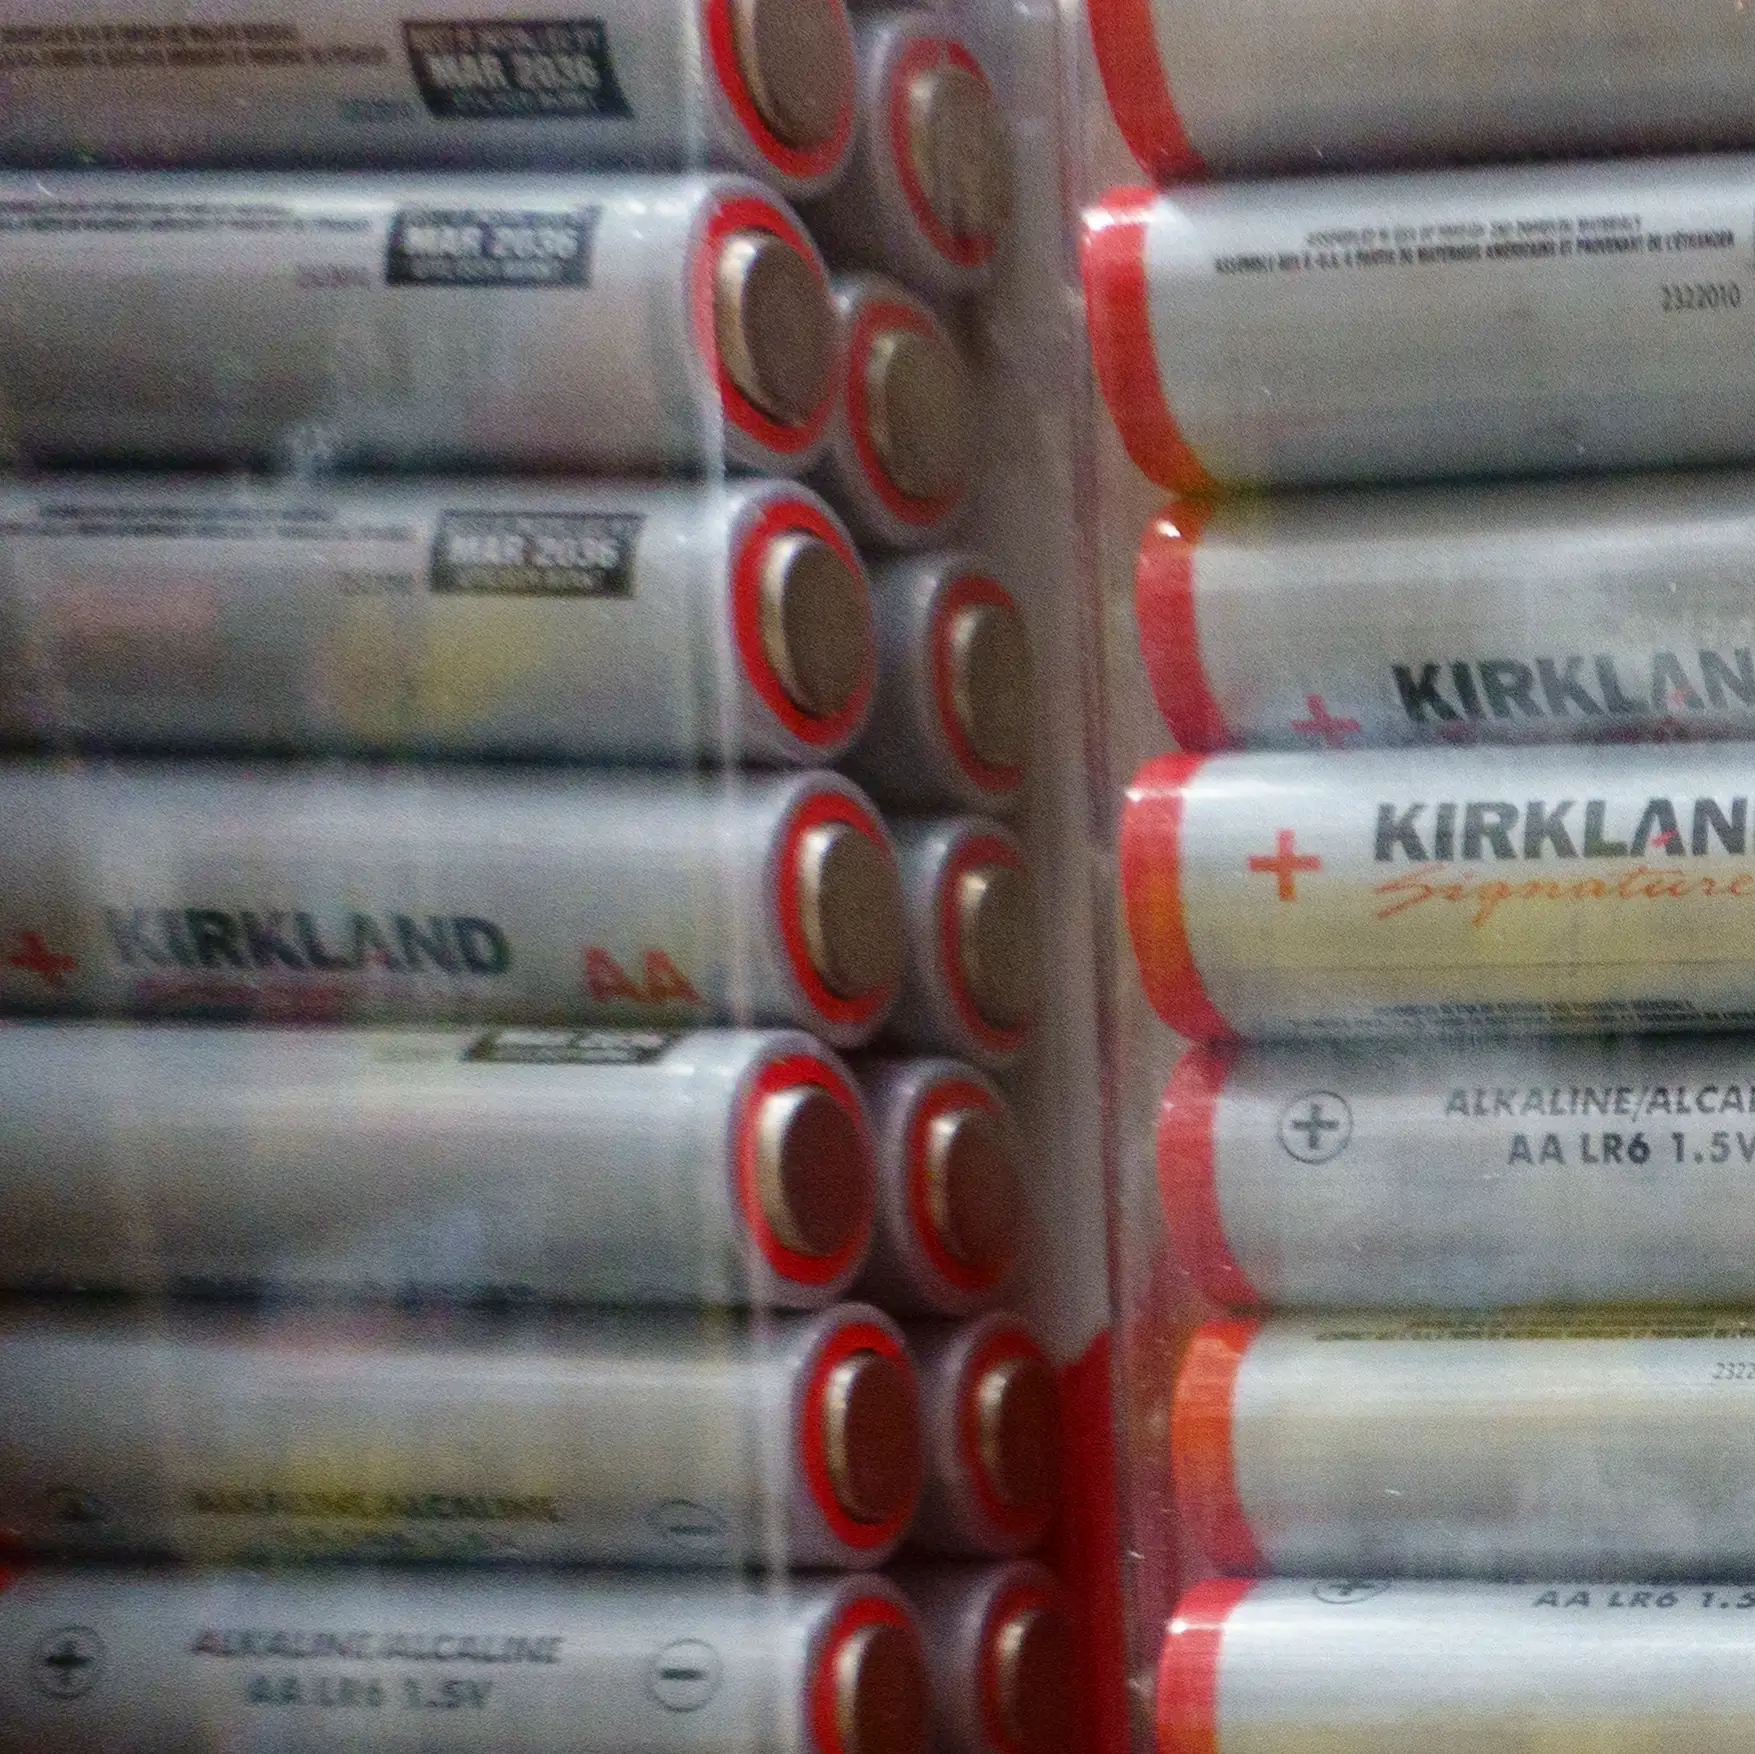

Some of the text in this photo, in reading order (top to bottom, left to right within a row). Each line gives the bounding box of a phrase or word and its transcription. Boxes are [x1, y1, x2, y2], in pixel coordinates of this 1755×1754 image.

[105, 907, 702, 1004] KIRKLAND AA
[1508, 1132, 1565, 1165] AA
[1580, 1132, 1650, 1165] LR6
[1532, 1590, 1590, 1608] AA
[1607, 1591, 1679, 1609] LR6
